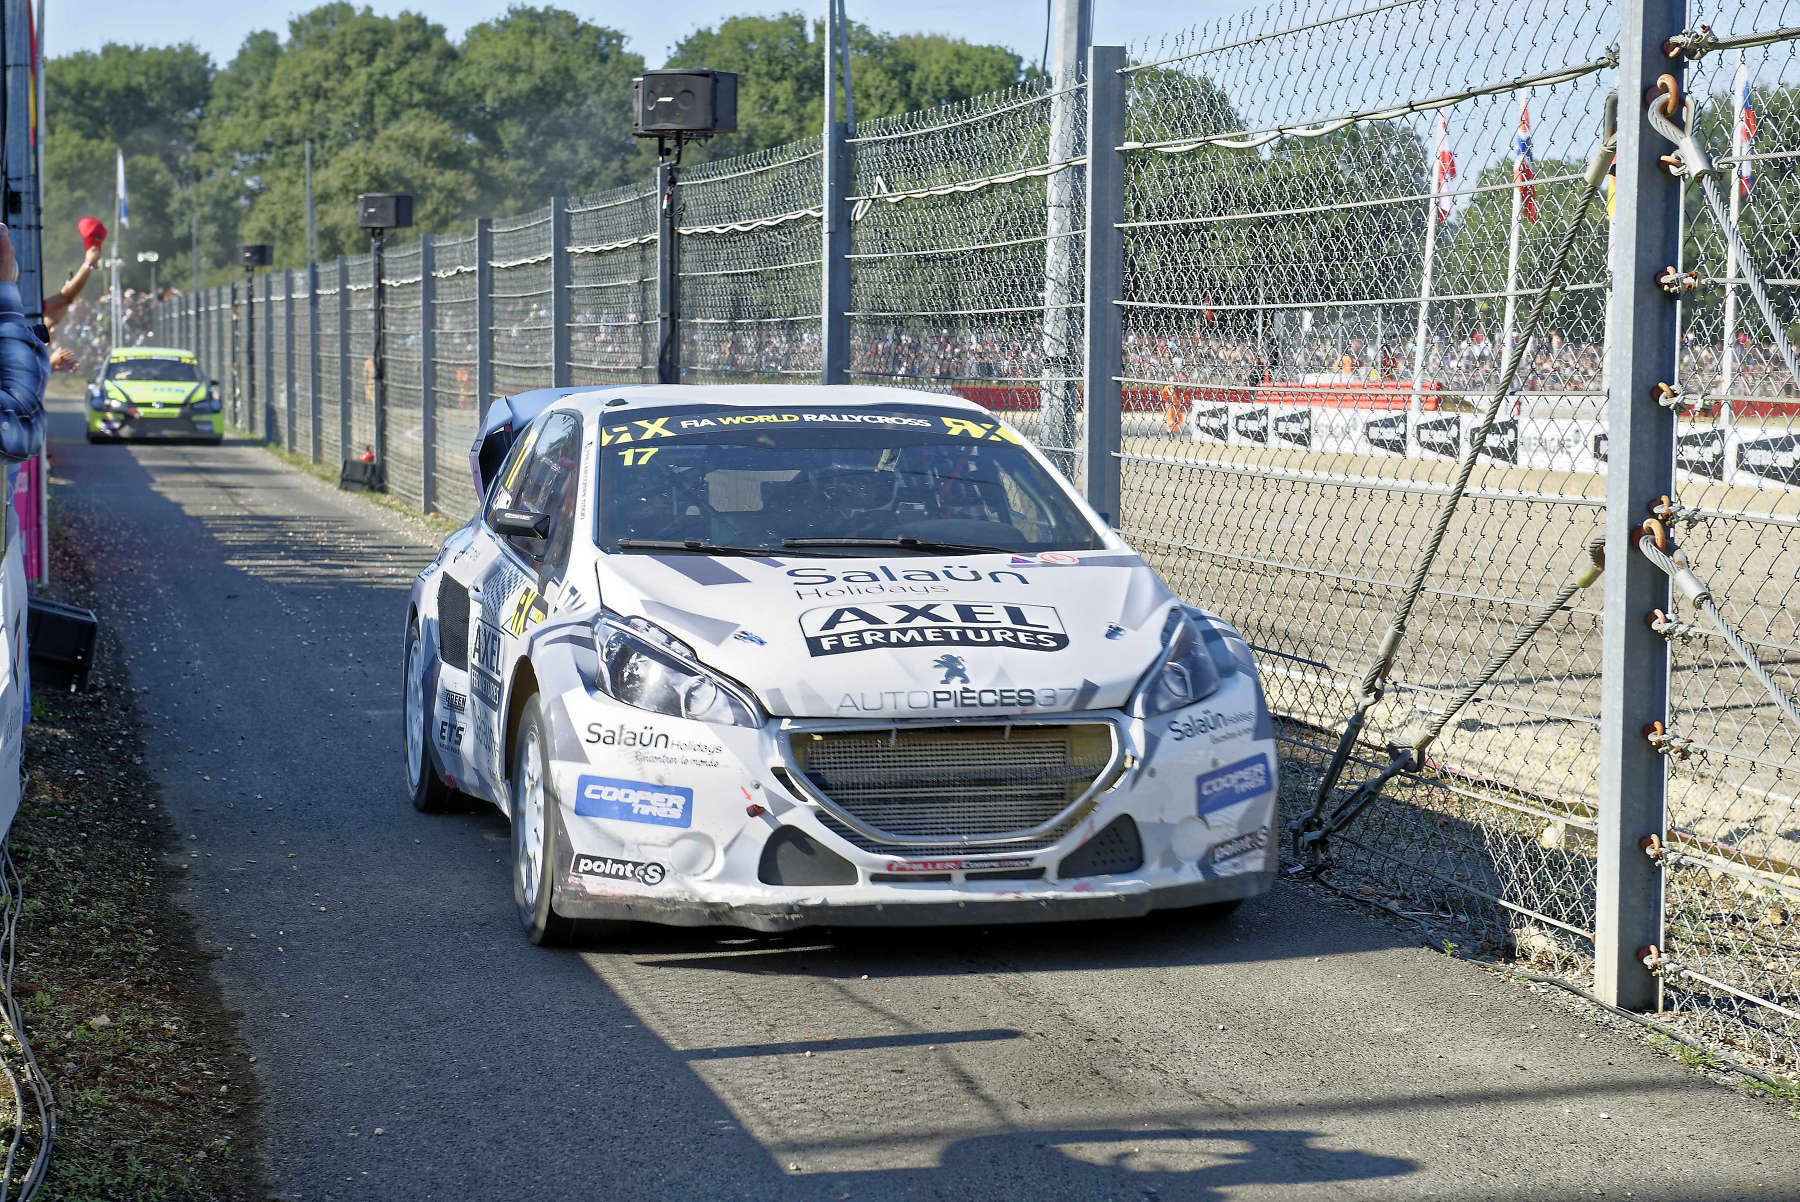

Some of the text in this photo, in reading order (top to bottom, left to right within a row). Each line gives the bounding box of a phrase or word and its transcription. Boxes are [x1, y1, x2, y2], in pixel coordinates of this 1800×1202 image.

[680, 418, 717, 429] FIA
[717, 413, 800, 425] WORLD
[801, 413, 932, 427] RALLYCROSS
[618, 447, 660, 466] 17
[786, 565, 1030, 585] Salaün
[795, 583, 950, 601] Holidays
[819, 603, 1050, 631] AXEL
[820, 628, 1058, 650] FERMETURES
[472, 624, 501, 677] AXEL
[439, 720, 466, 748] ETS
[585, 722, 669, 749] Salaün
[1167, 709, 1228, 742] Salaün
[583, 784, 687, 810] COOPER
[631, 803, 684, 820] TIRES
[578, 858, 635, 878] point
